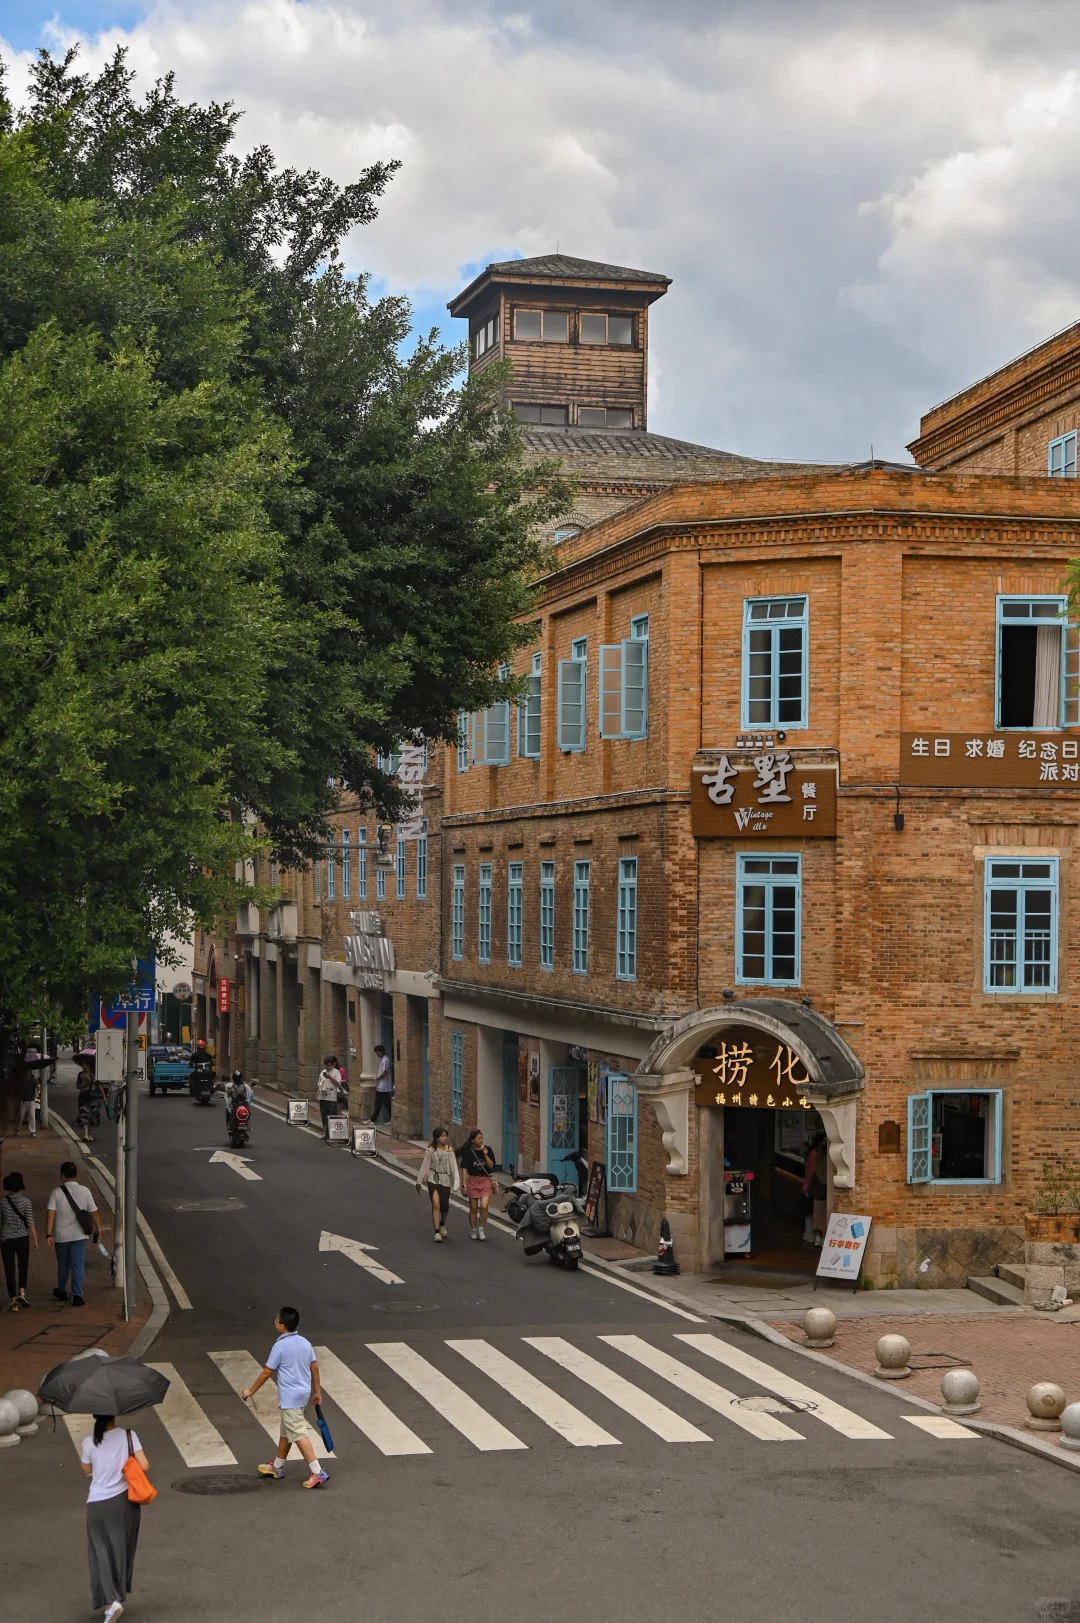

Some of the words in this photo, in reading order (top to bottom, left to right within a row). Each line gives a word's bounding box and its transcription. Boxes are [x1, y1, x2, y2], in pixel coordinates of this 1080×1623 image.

[911, 738, 950, 757] 生日
[965, 738, 1005, 758] 求婚
[1018, 739, 1078, 761] 纪念日
[701, 754, 794, 804] 古墅
[1039, 761, 1080, 782] 派对
[801, 782, 817, 821] 餐厅
[738, 806, 773, 821] Vintage
[712, 1041, 810, 1087] 捞化
[715, 1092, 811, 1109] 福州特色小吃
